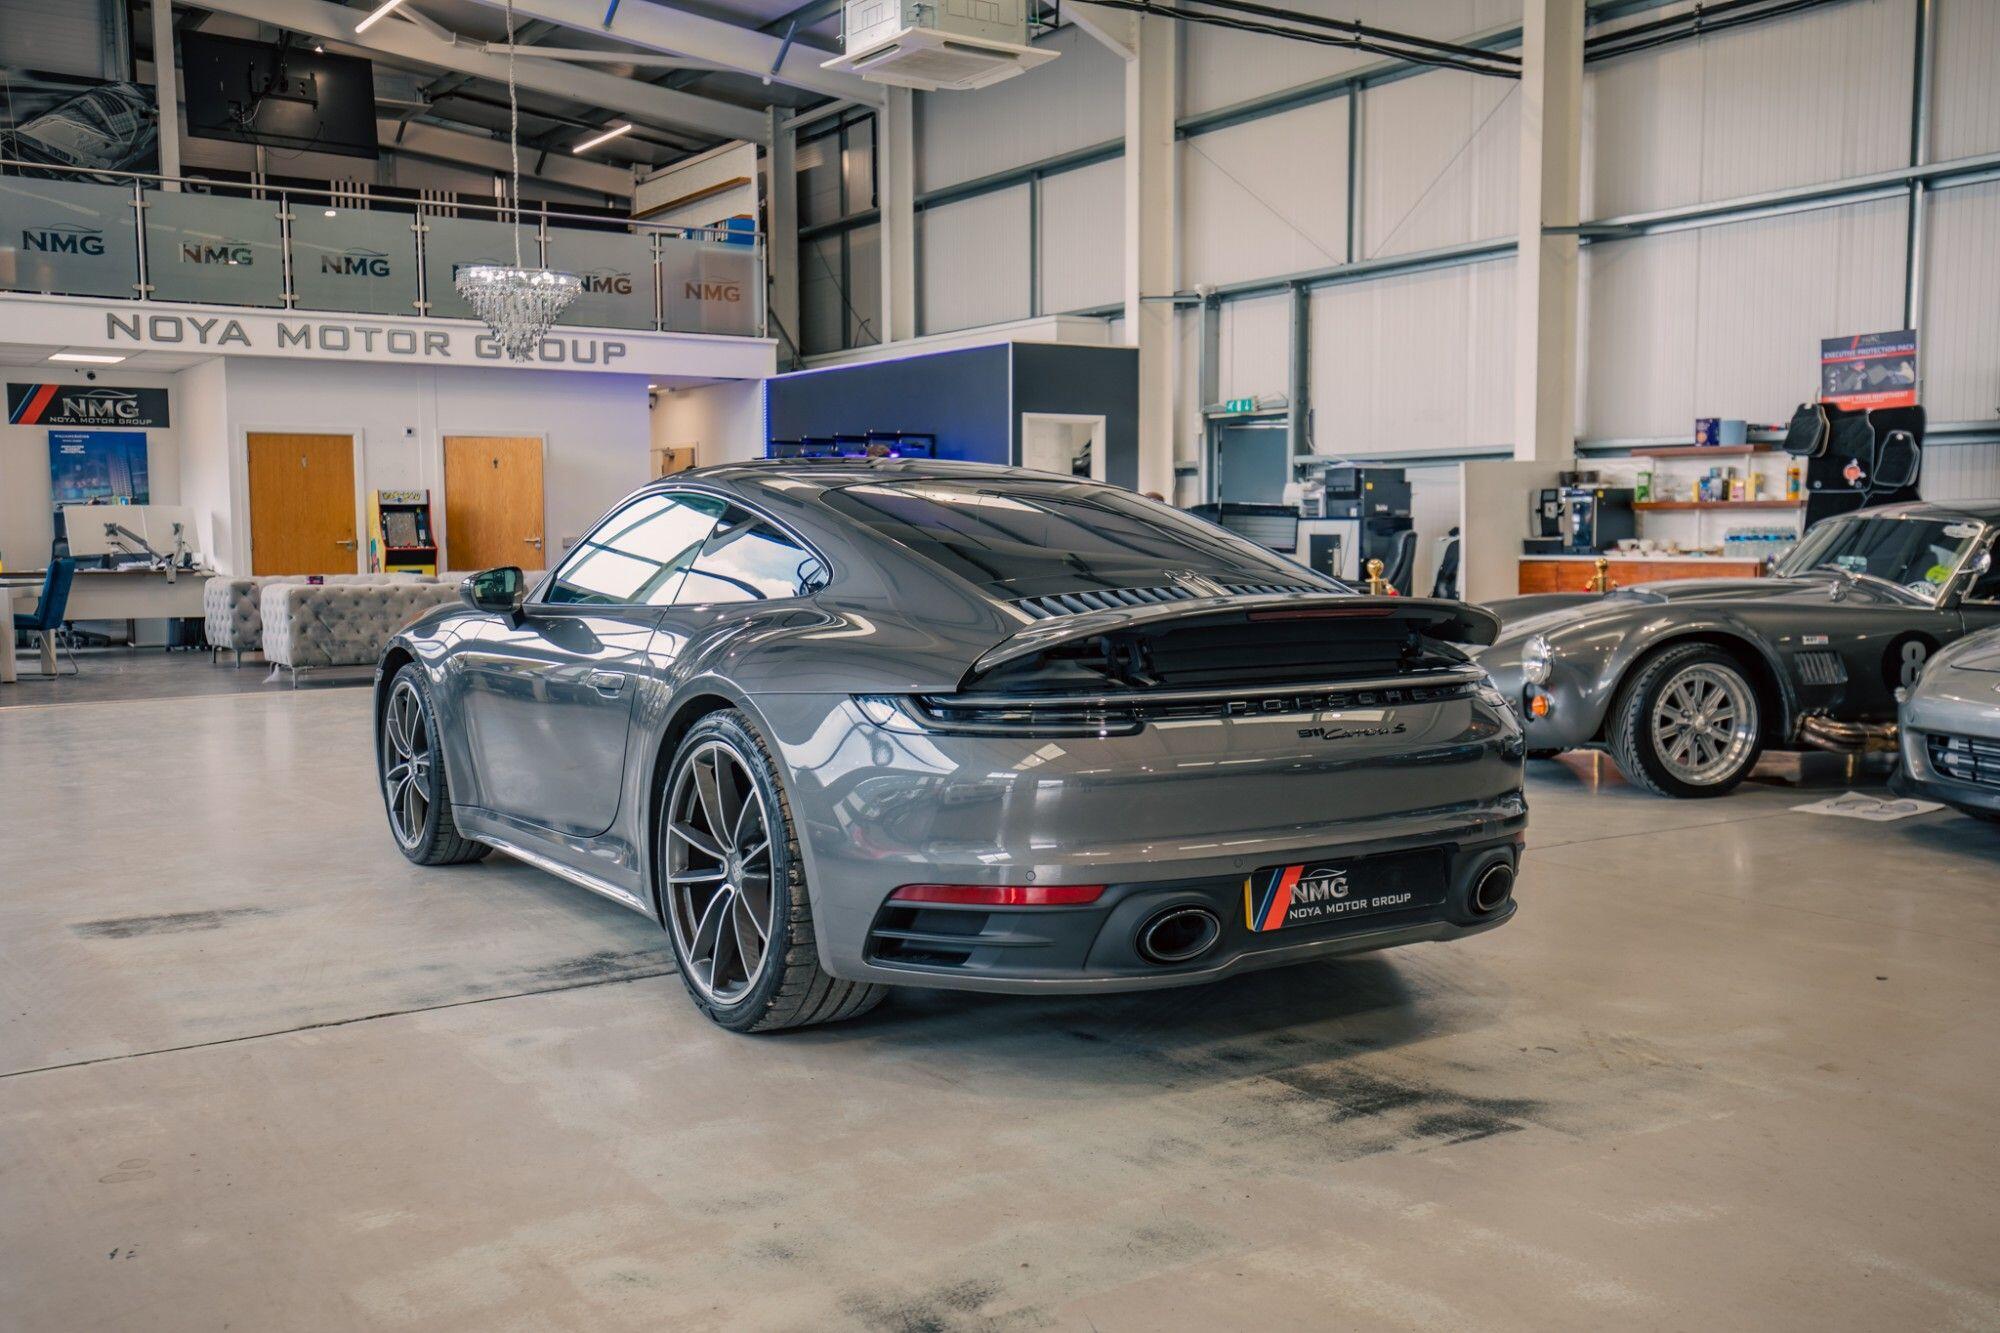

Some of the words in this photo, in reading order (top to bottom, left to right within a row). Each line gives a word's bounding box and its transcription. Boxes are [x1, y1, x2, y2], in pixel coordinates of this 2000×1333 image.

[22, 230, 104, 256] NMG
[179, 243, 254, 266] NMG
[321, 254, 391, 278] NMG
[685, 283, 741, 302] NMG
[106, 311, 251, 347] NOYA
[277, 322, 450, 357] MOTOR
[62, 398, 140, 419] NMG
[49, 416, 76, 424] NOYA
[80, 417, 115, 425] MOTOR
[119, 418, 152, 426] GROUP
[1391, 723, 1406, 735] S
[1289, 876, 1349, 905] NMG
[1289, 907, 1322, 920] NOYA
[1326, 901, 1367, 914] MOTOR
[1372, 893, 1411, 907] GROUP
